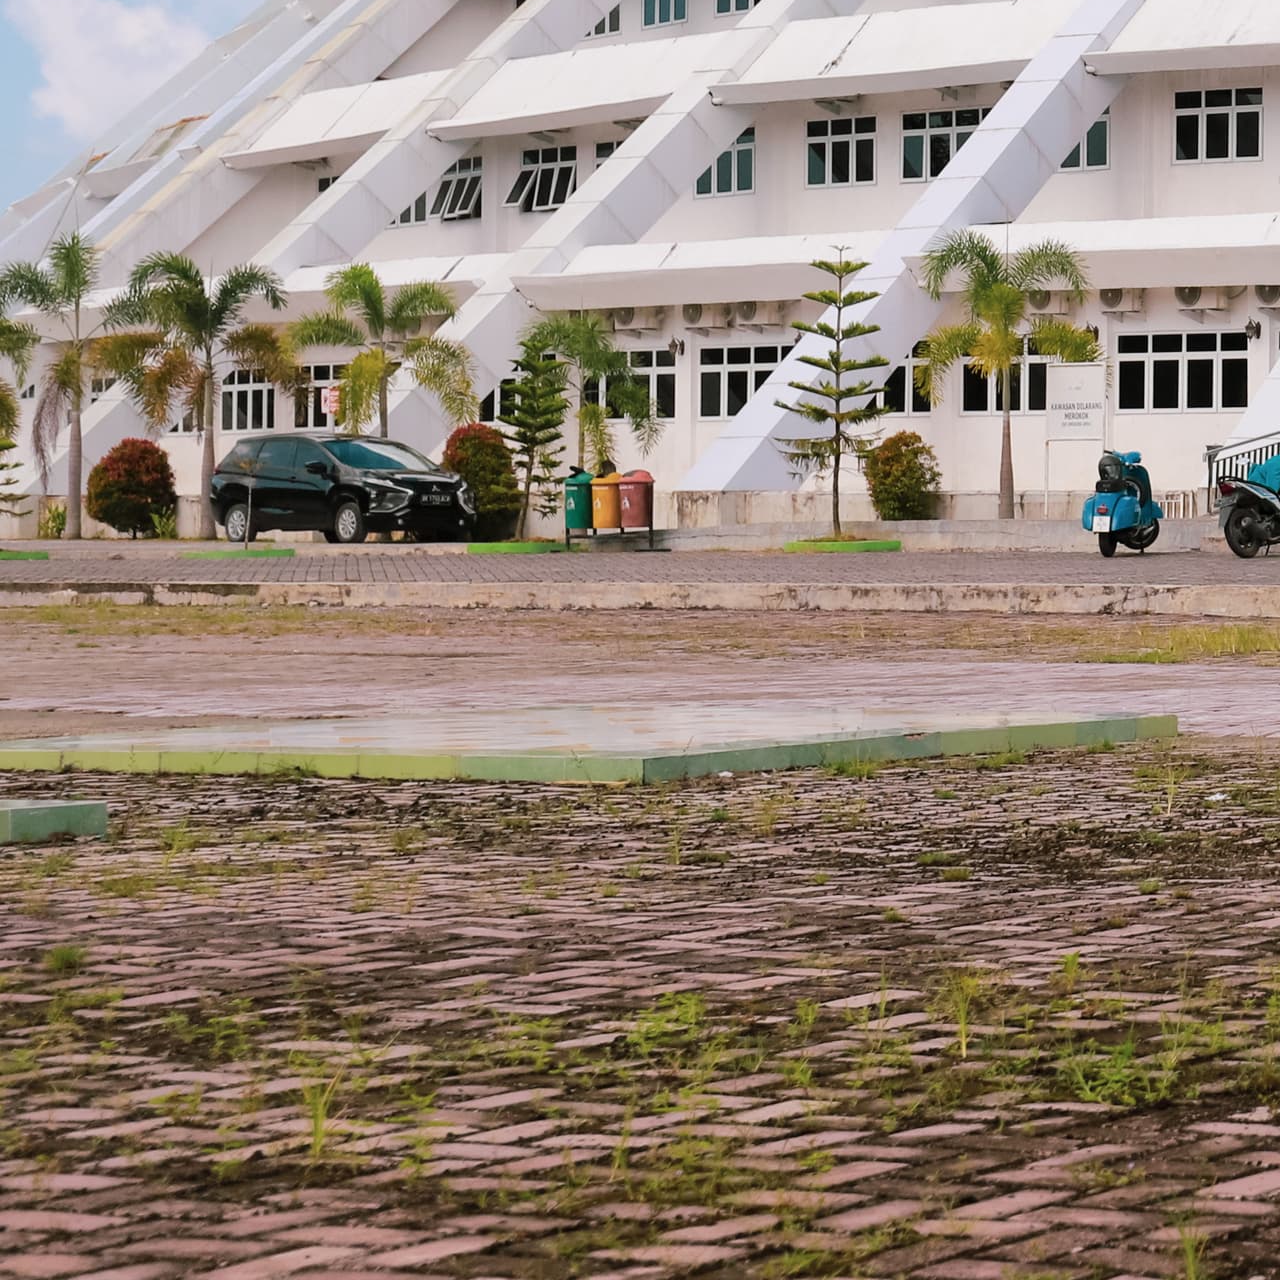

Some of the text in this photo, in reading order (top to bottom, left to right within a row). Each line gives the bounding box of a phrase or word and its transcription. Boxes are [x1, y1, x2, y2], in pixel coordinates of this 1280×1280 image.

[1051, 402, 1103, 410] KAWASAN DILARANG
[1064, 412, 1089, 420] MEROKOK
